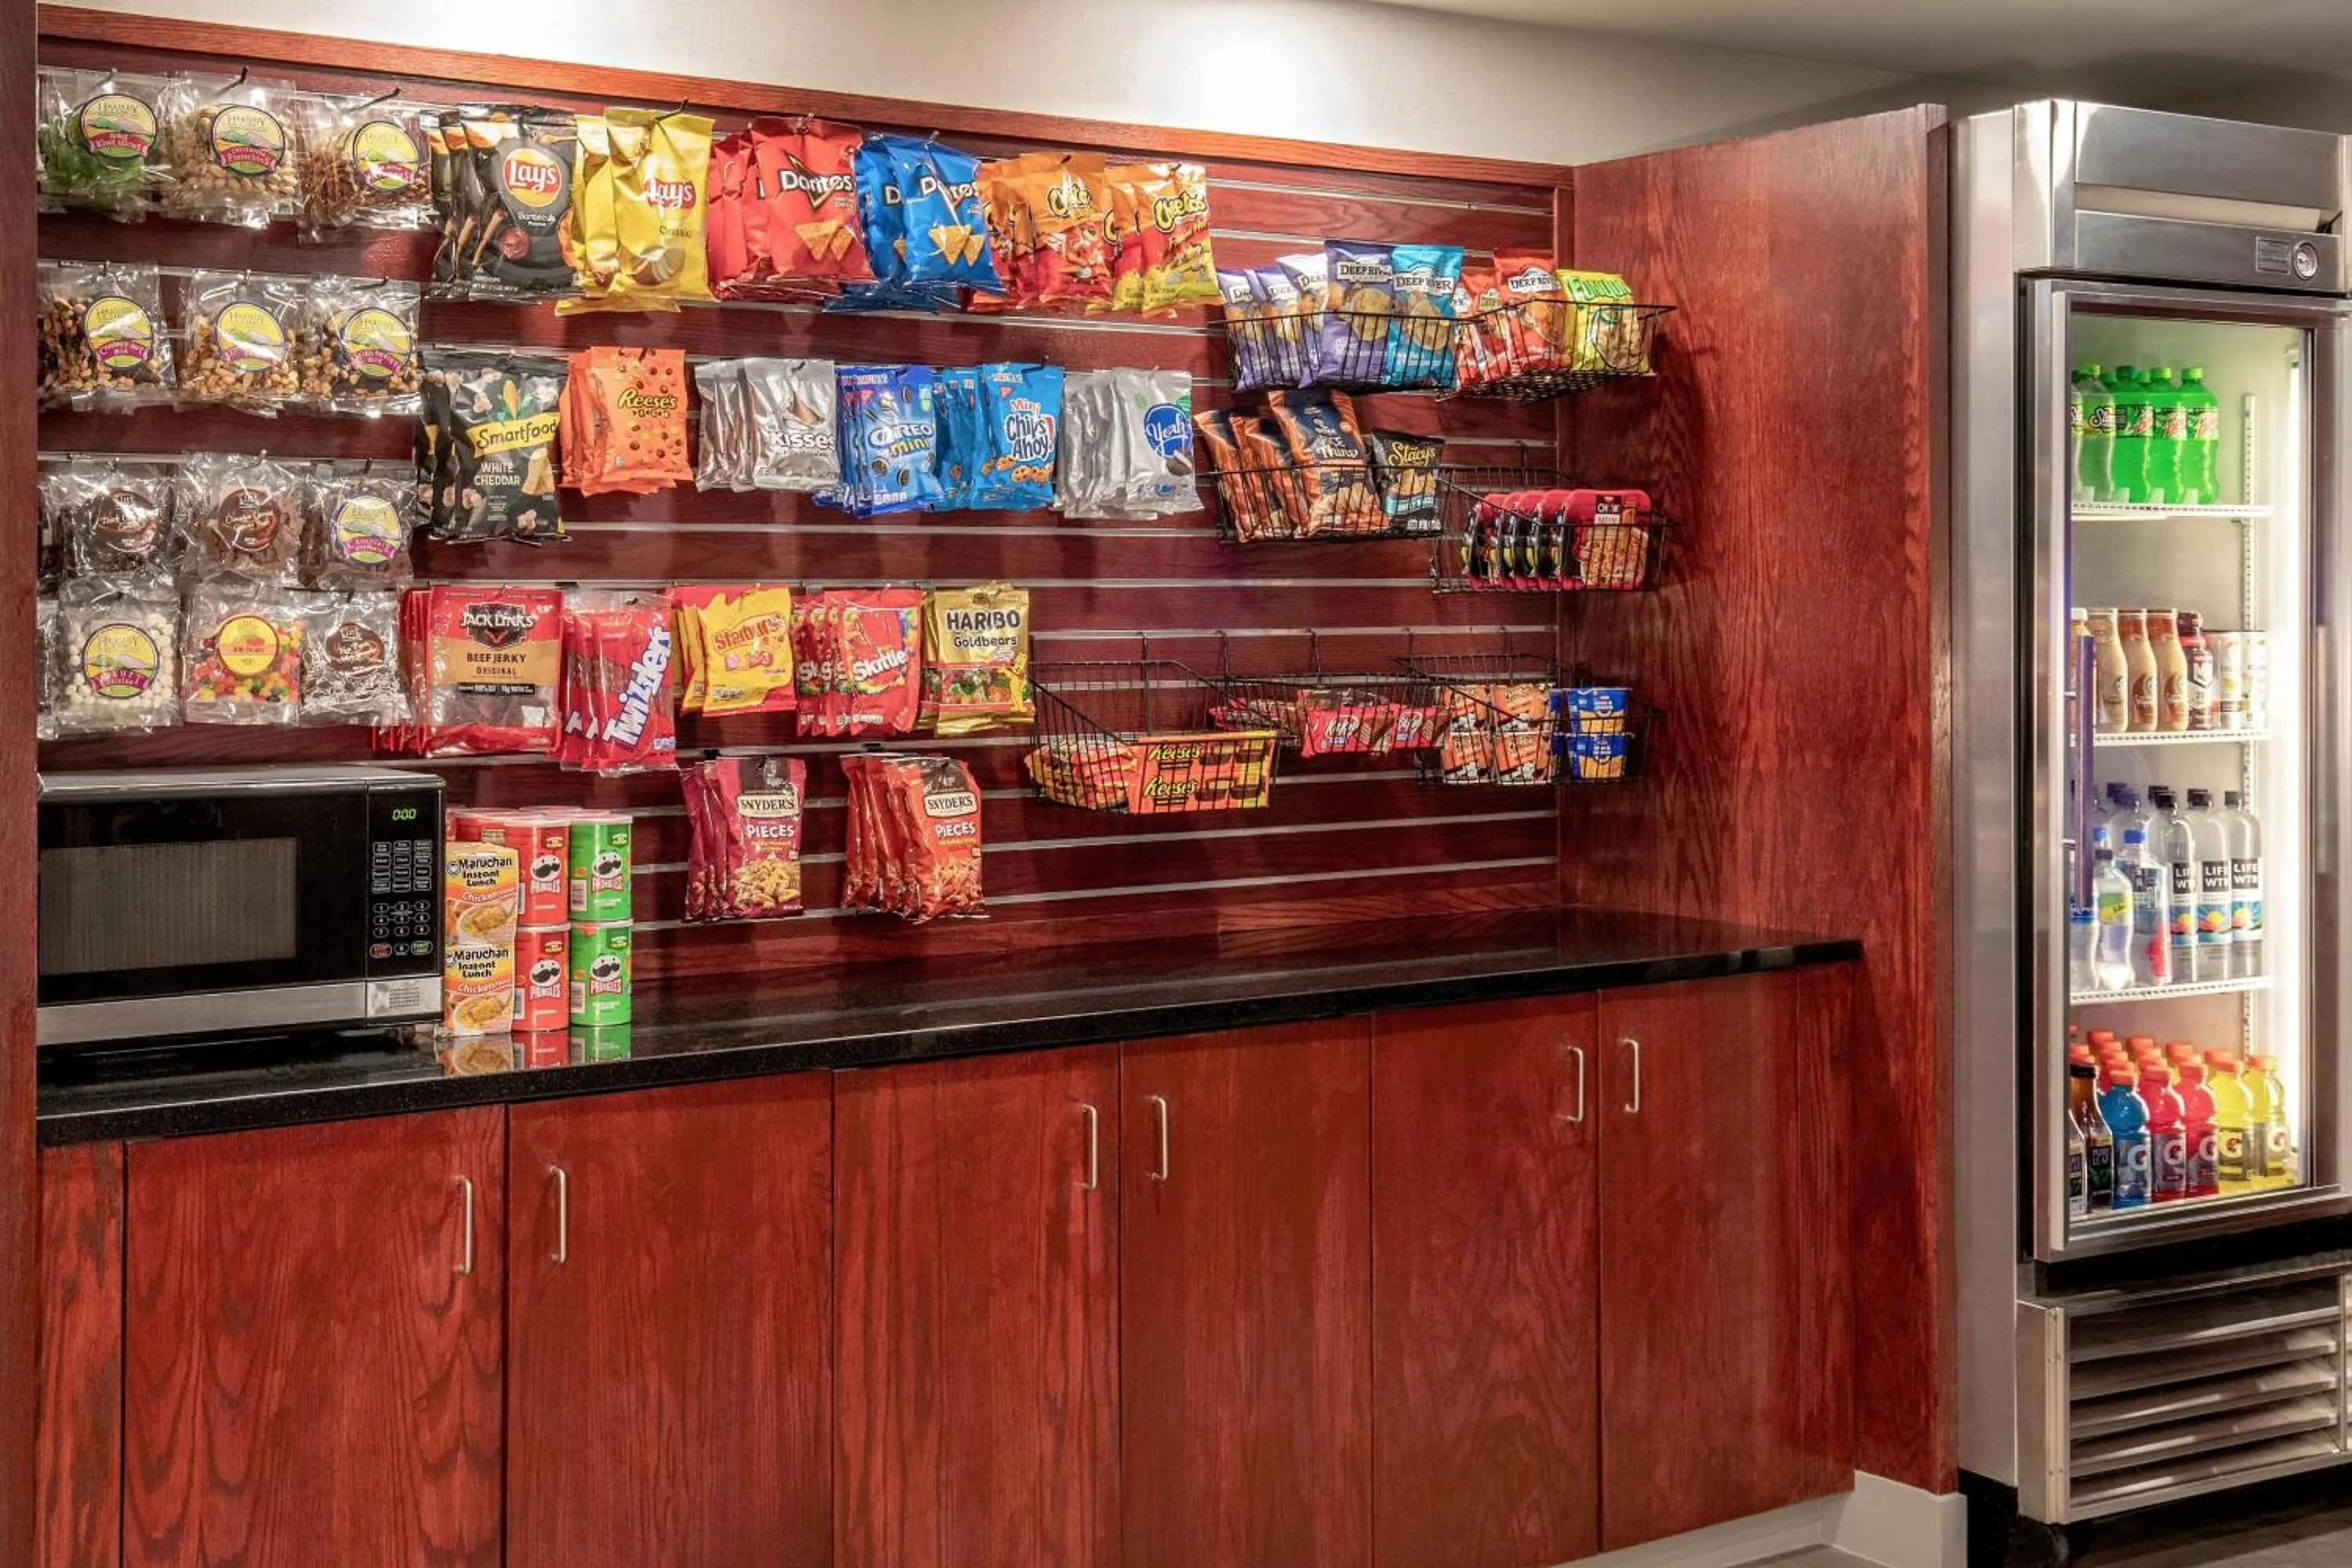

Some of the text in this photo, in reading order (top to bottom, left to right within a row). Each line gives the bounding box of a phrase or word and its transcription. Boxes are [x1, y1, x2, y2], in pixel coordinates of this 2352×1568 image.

[779, 169, 854, 194] Doritos
[1340, 264, 1367, 275] DEEP
[1396, 277, 1425, 287] DEEP
[617, 387, 678, 410] Reese's
[476, 418, 557, 449] Smartfood
[870, 423, 933, 446] OREO
[480, 461, 514, 474] WHITE
[474, 474, 521, 486] CHEDDAR
[460, 612, 493, 627] JACK
[946, 610, 1021, 630] HARIBO
[953, 635, 1018, 648] Goldbears
[466, 653, 526, 663] BEEF JERKY
[476, 666, 517, 675] ORIGINAL
[746, 823, 795, 839] PIECES
[935, 821, 976, 838] PIECES
[459, 856, 513, 869] Maruchan
[463, 869, 499, 879] Instant
[466, 877, 496, 887] Lunch
[454, 948, 509, 960] Maruchan
[459, 960, 496, 971] Instant
[463, 969, 492, 978] Lunch
[2220, 1131, 2243, 1158] G
[2162, 1138, 2184, 1166] G
